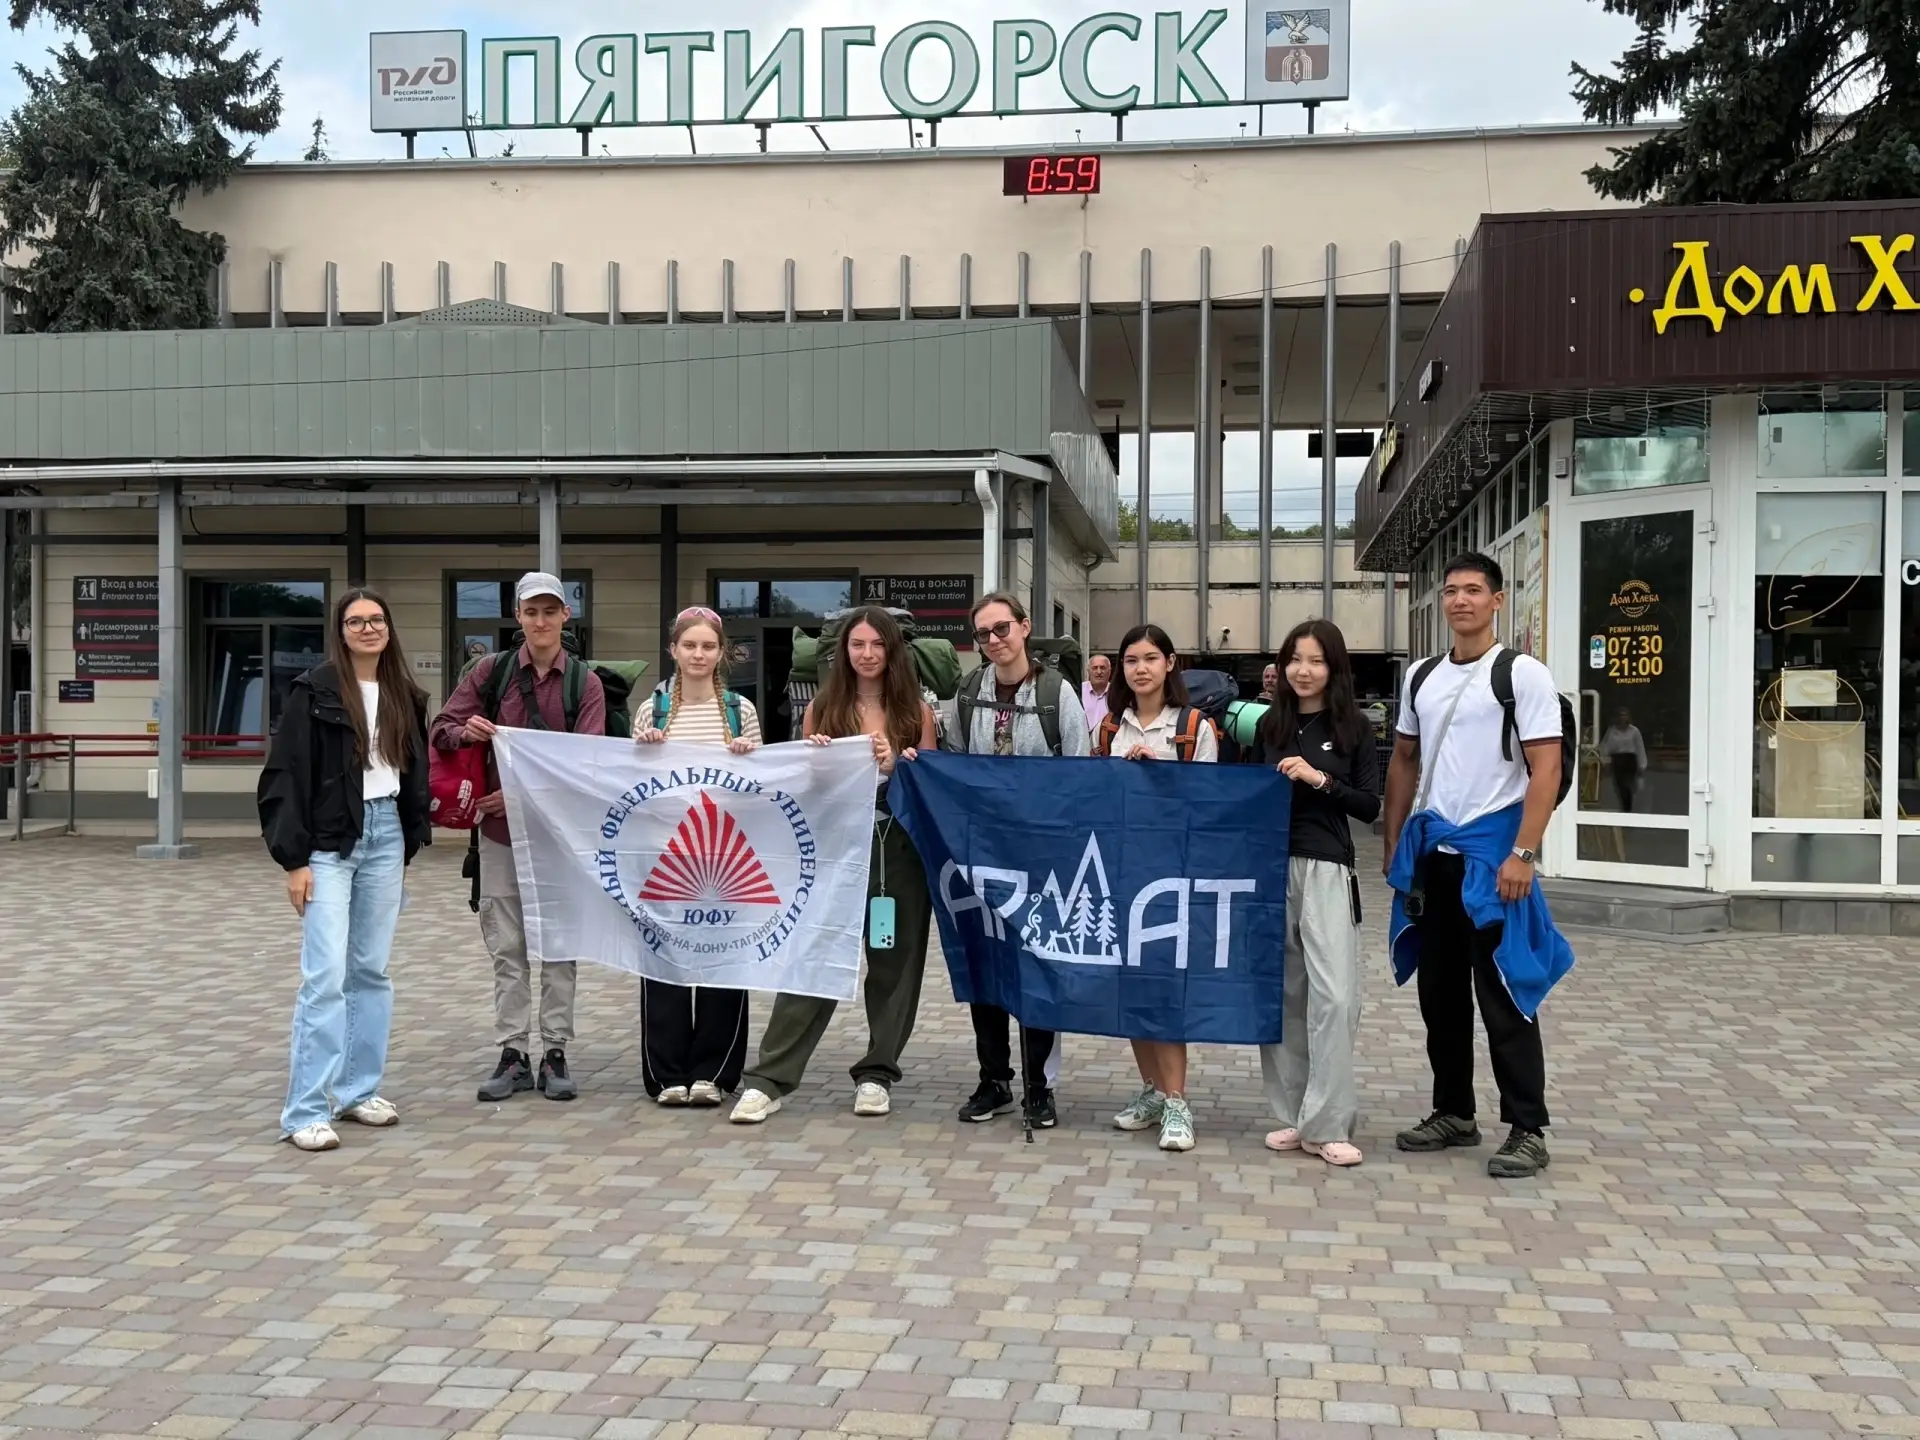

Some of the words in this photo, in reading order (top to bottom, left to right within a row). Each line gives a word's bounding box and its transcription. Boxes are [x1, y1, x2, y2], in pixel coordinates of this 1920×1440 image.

[482, 9, 1229, 129] ПЯТИГОРСК
[1028, 157, 1097, 192] 8:59
[101, 579, 127, 590] Вход
[128, 581, 135, 589] в
[890, 579, 917, 589] Вход
[919, 580, 926, 588] в
[928, 579, 967, 588] вокзал
[101, 592, 135, 600] Entrance
[890, 592, 926, 600] Entrance
[927, 592, 936, 600] to
[937, 591, 966, 600] station
[92, 622, 148, 632] Досмотровая
[943, 624, 965, 632] зона
[1633, 624, 1660, 632] РАБОТЫ
[1608, 635, 1663, 656] 07:30
[1608, 656, 1663, 677] 21:00
[601, 767, 765, 840] ФЕДЕРАЛЬНЫЙ
[757, 790, 816, 962] УНИВЕРСИТЕТ
[683, 908, 737, 926] ЮФУ
